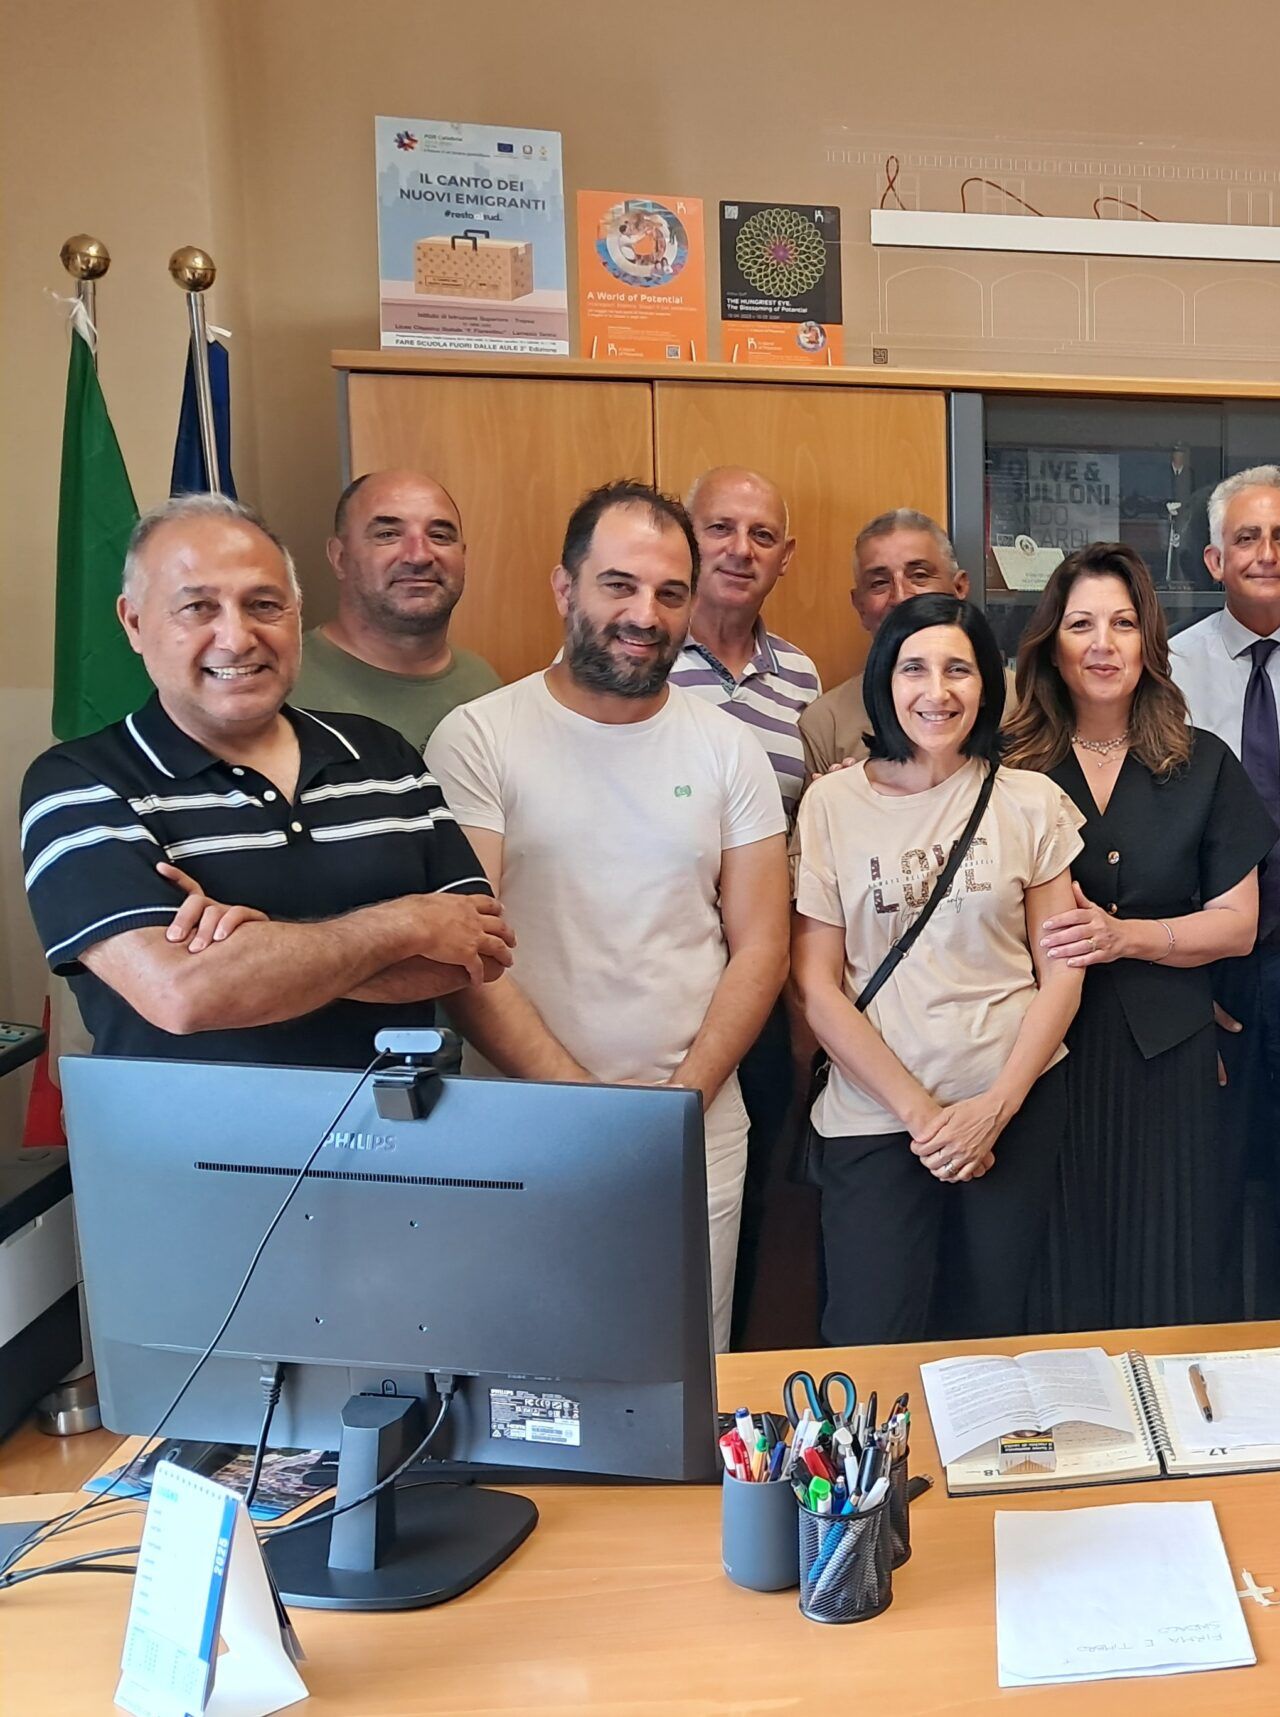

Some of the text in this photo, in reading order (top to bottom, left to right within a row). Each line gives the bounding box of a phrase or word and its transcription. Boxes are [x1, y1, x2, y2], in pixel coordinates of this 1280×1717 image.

[420, 173, 524, 192] IL CANTO DEI
[400, 188, 546, 211] NUOVI EMIGRANTI
[587, 291, 683, 304] A World of Potential
[726, 297, 739, 305] THE
[740, 298, 776, 307] HUNGRIEST
[739, 304, 773, 313] Blossoming
[416, 340, 448, 348] SCUOLA
[449, 341, 472, 349] FUORI
[474, 342, 497, 350] DALLE
[1083, 461, 1101, 482] &
[322, 1132, 397, 1152] PHILIPS
[1208, 1448, 1229, 1456] 17
[213, 1536, 229, 1576] 2025
[1143, 1638, 1155, 1648] E
[1167, 1632, 1223, 1644] FIRMA
